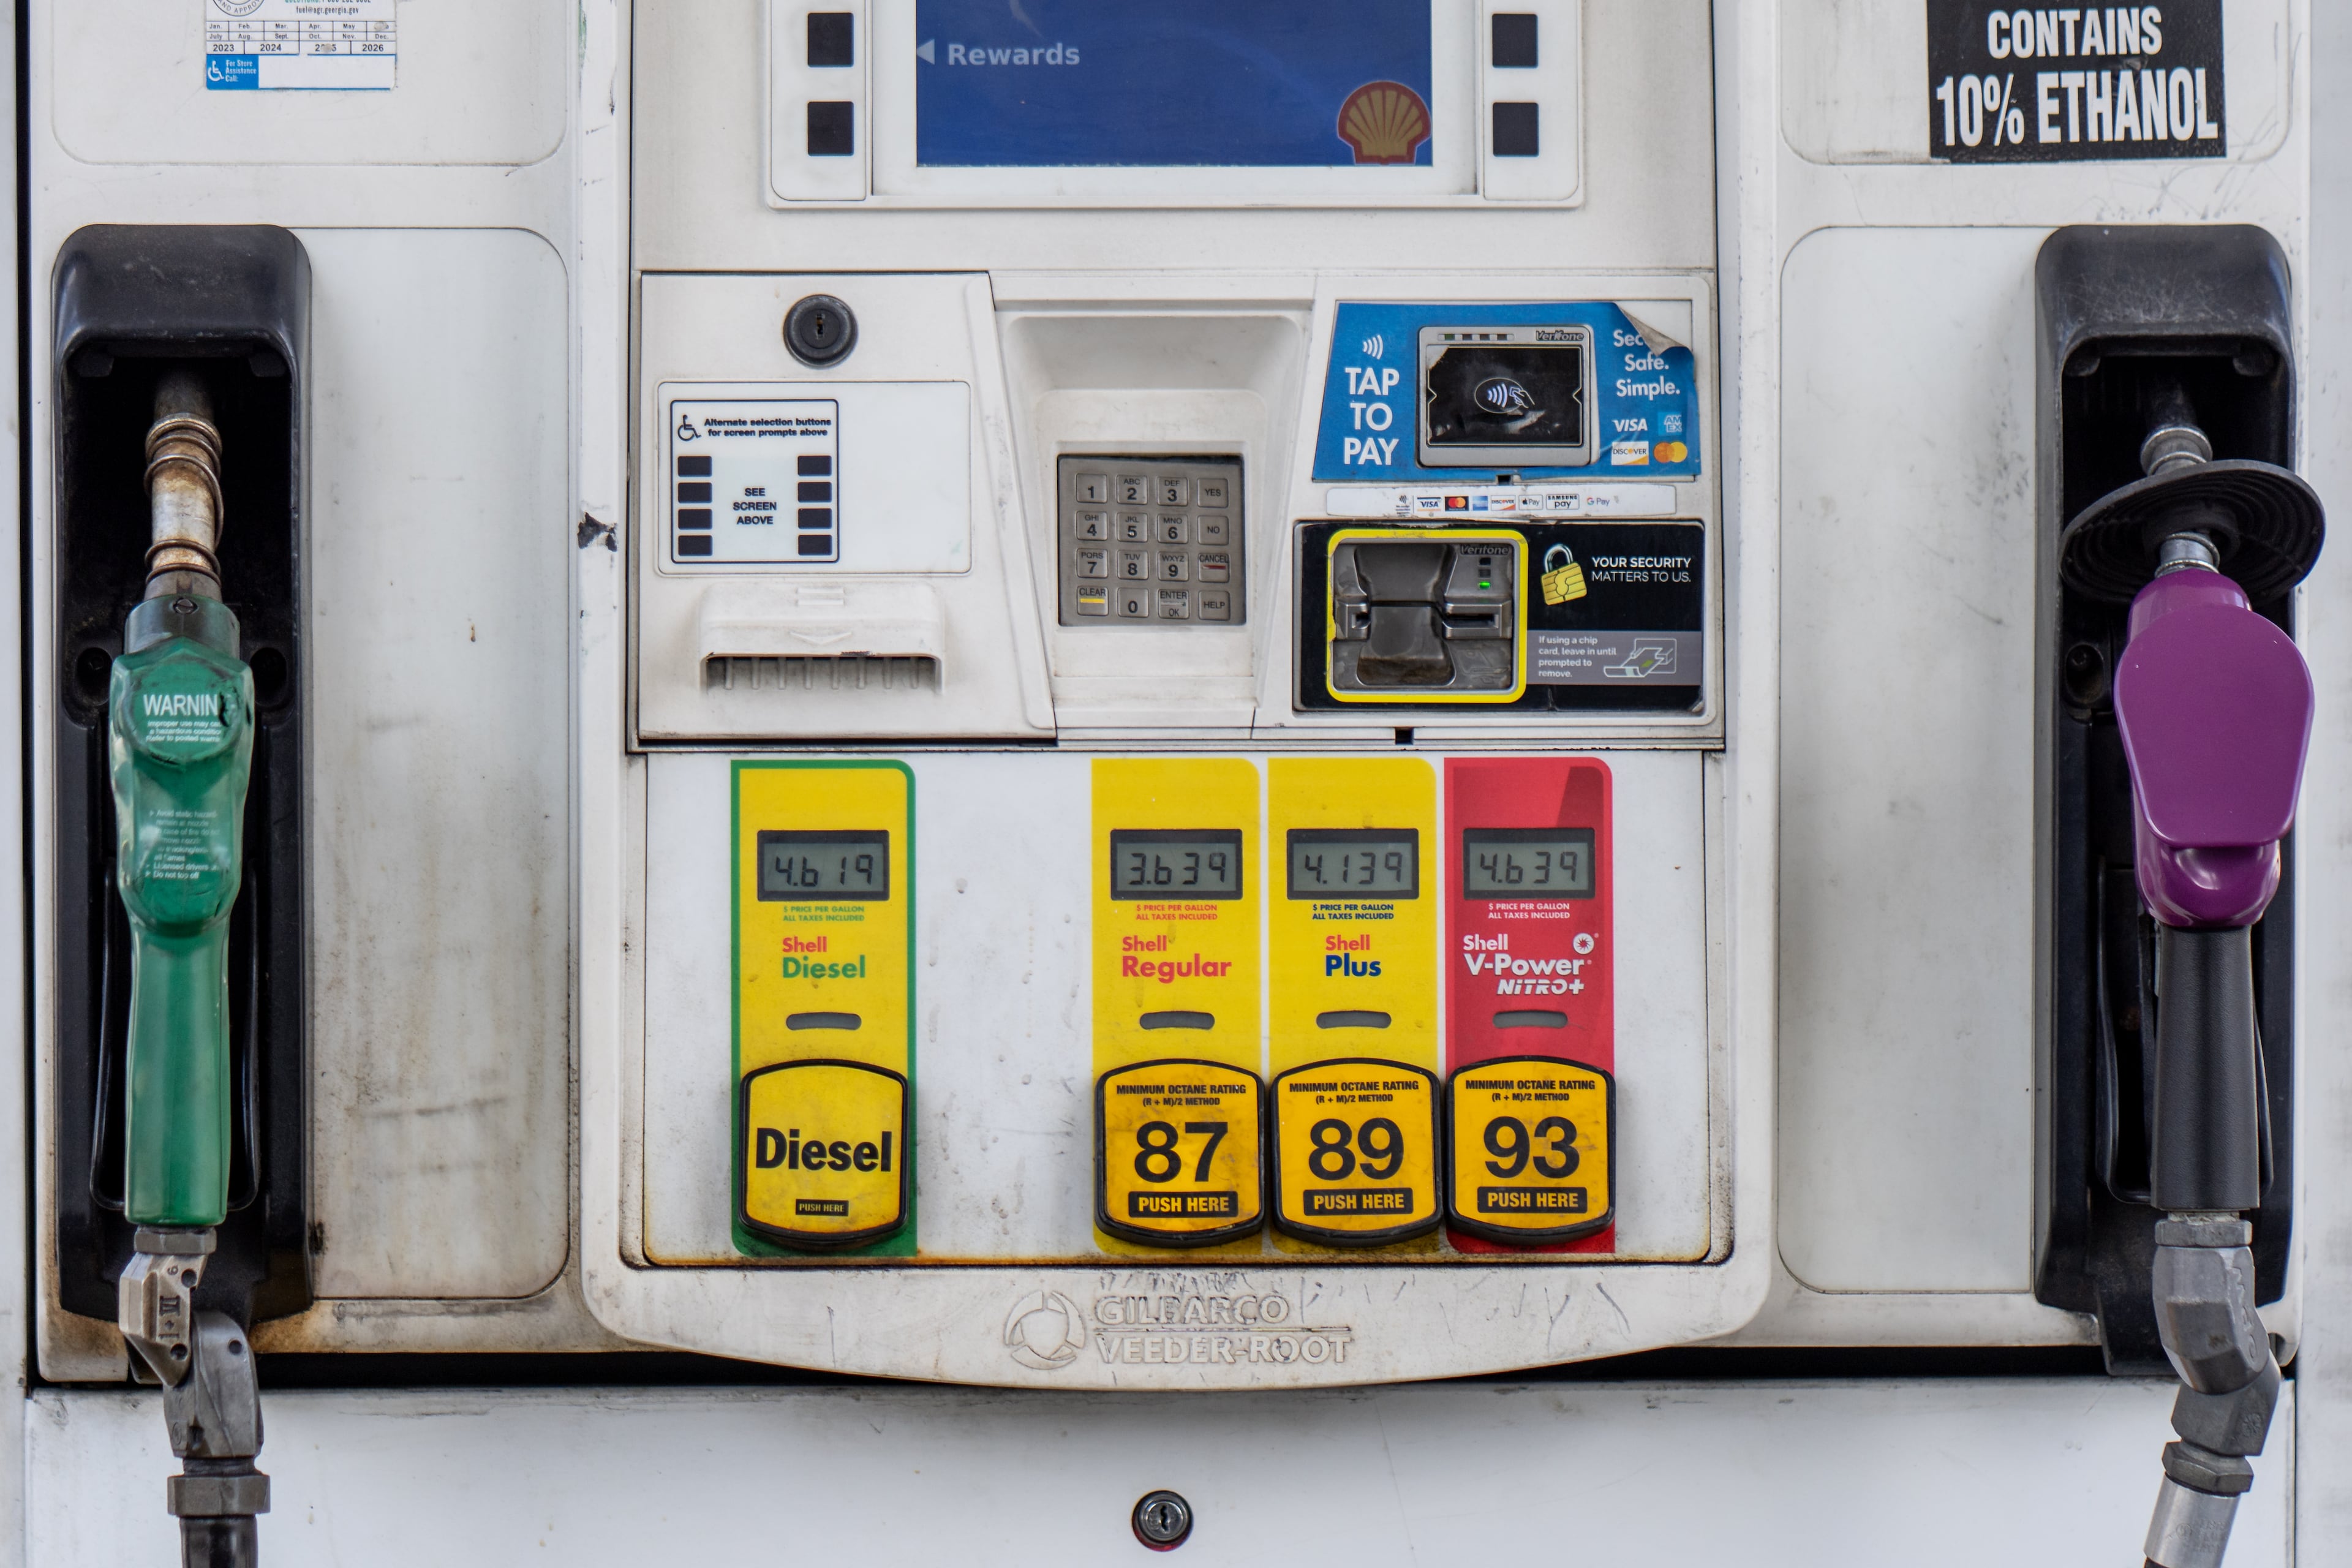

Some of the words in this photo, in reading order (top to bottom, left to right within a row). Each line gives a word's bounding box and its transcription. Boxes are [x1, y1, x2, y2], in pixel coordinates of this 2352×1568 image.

[1988, 6, 2162, 59] CONTAINS
[362, 43, 384, 52] 2026
[948, 42, 1080, 66] Rewards
[1936, 72, 2025, 147] 10%
[2037, 67, 2218, 143] ETHANOL
[1624, 352, 1669, 372] Safe.
[1344, 367, 1400, 396] TAP
[1616, 375, 1681, 401] Simple.
[1349, 402, 1393, 431] TO
[1611, 418, 1648, 432] VISA
[758, 429, 797, 438] prompts
[1344, 437, 1400, 466] PAY
[745, 488, 766, 497] SEE
[1087, 486, 1095, 499] 1
[1126, 487, 1137, 500] 2
[1167, 488, 1178, 502] 3
[733, 502, 777, 511] SCREEN
[737, 516, 774, 525] ABOVE
[1087, 524, 1097, 537] 4
[1127, 525, 1137, 538] 5
[1168, 527, 1178, 540] 6
[1199, 554, 1229, 564] CANCEL
[1592, 557, 1627, 568] YOUR
[1630, 557, 1691, 568] SECURITY
[1087, 561, 1098, 574] 7
[1128, 563, 1138, 576] 8
[1168, 564, 1178, 578] 9
[1592, 571, 1649, 582] MATTERS
[1652, 572, 1669, 582] TO
[1672, 572, 1691, 582] US.
[1079, 587, 1106, 597] CLEAR
[1160, 590, 1188, 600] ENTER
[1128, 600, 1138, 614] 0
[1168, 608, 1180, 617] OK
[1547, 636, 1570, 646] using
[1579, 636, 1598, 646] chip
[1539, 647, 1560, 656] card,
[1539, 658, 1581, 668] prompted
[143, 693, 219, 716] WARNIN
[1128, 852, 1227, 886] 3.639
[1304, 852, 1403, 885] 4.139
[1479, 851, 1578, 884] 4.639
[782, 935, 827, 952] Shell
[1122, 935, 1167, 952] Shell
[1325, 934, 1370, 951] Shell
[1463, 933, 1509, 951] Shell
[782, 954, 865, 979] Diesel
[1122, 953, 1232, 984] Regular
[1325, 952, 1382, 977] Plus
[1463, 953, 1585, 976] V-Power
[1117, 1085, 1165, 1095] MINIMUM
[1168, 1085, 1207, 1094] OCTANE
[1210, 1084, 1246, 1094] RATING
[1289, 1083, 1338, 1092] MINIMUM
[1341, 1082, 1380, 1091] OCTANE
[1382, 1080, 1419, 1090] RATING
[1466, 1080, 1514, 1090] MINIMUM
[1517, 1080, 1556, 1090] OCTANE
[1559, 1080, 1596, 1090] RATING
[756, 1127, 892, 1172] Diesel
[1134, 1120, 1228, 1183] 87
[1308, 1117, 1404, 1181] 89
[1483, 1115, 1580, 1179] 93
[1138, 1197, 1182, 1212] PUSH
[1187, 1197, 1229, 1212] HERE
[1314, 1194, 1357, 1210] PUSH
[1362, 1194, 1404, 1209] HERE
[1488, 1192, 1531, 1207] PUSH
[1536, 1193, 1578, 1207] HERE
[799, 1203, 821, 1212] PUSH
[823, 1204, 845, 1212] HERE
[1095, 1294, 1288, 1325] GILBARCO
[1095, 1335, 1351, 1364] VEEDER-ROOT
